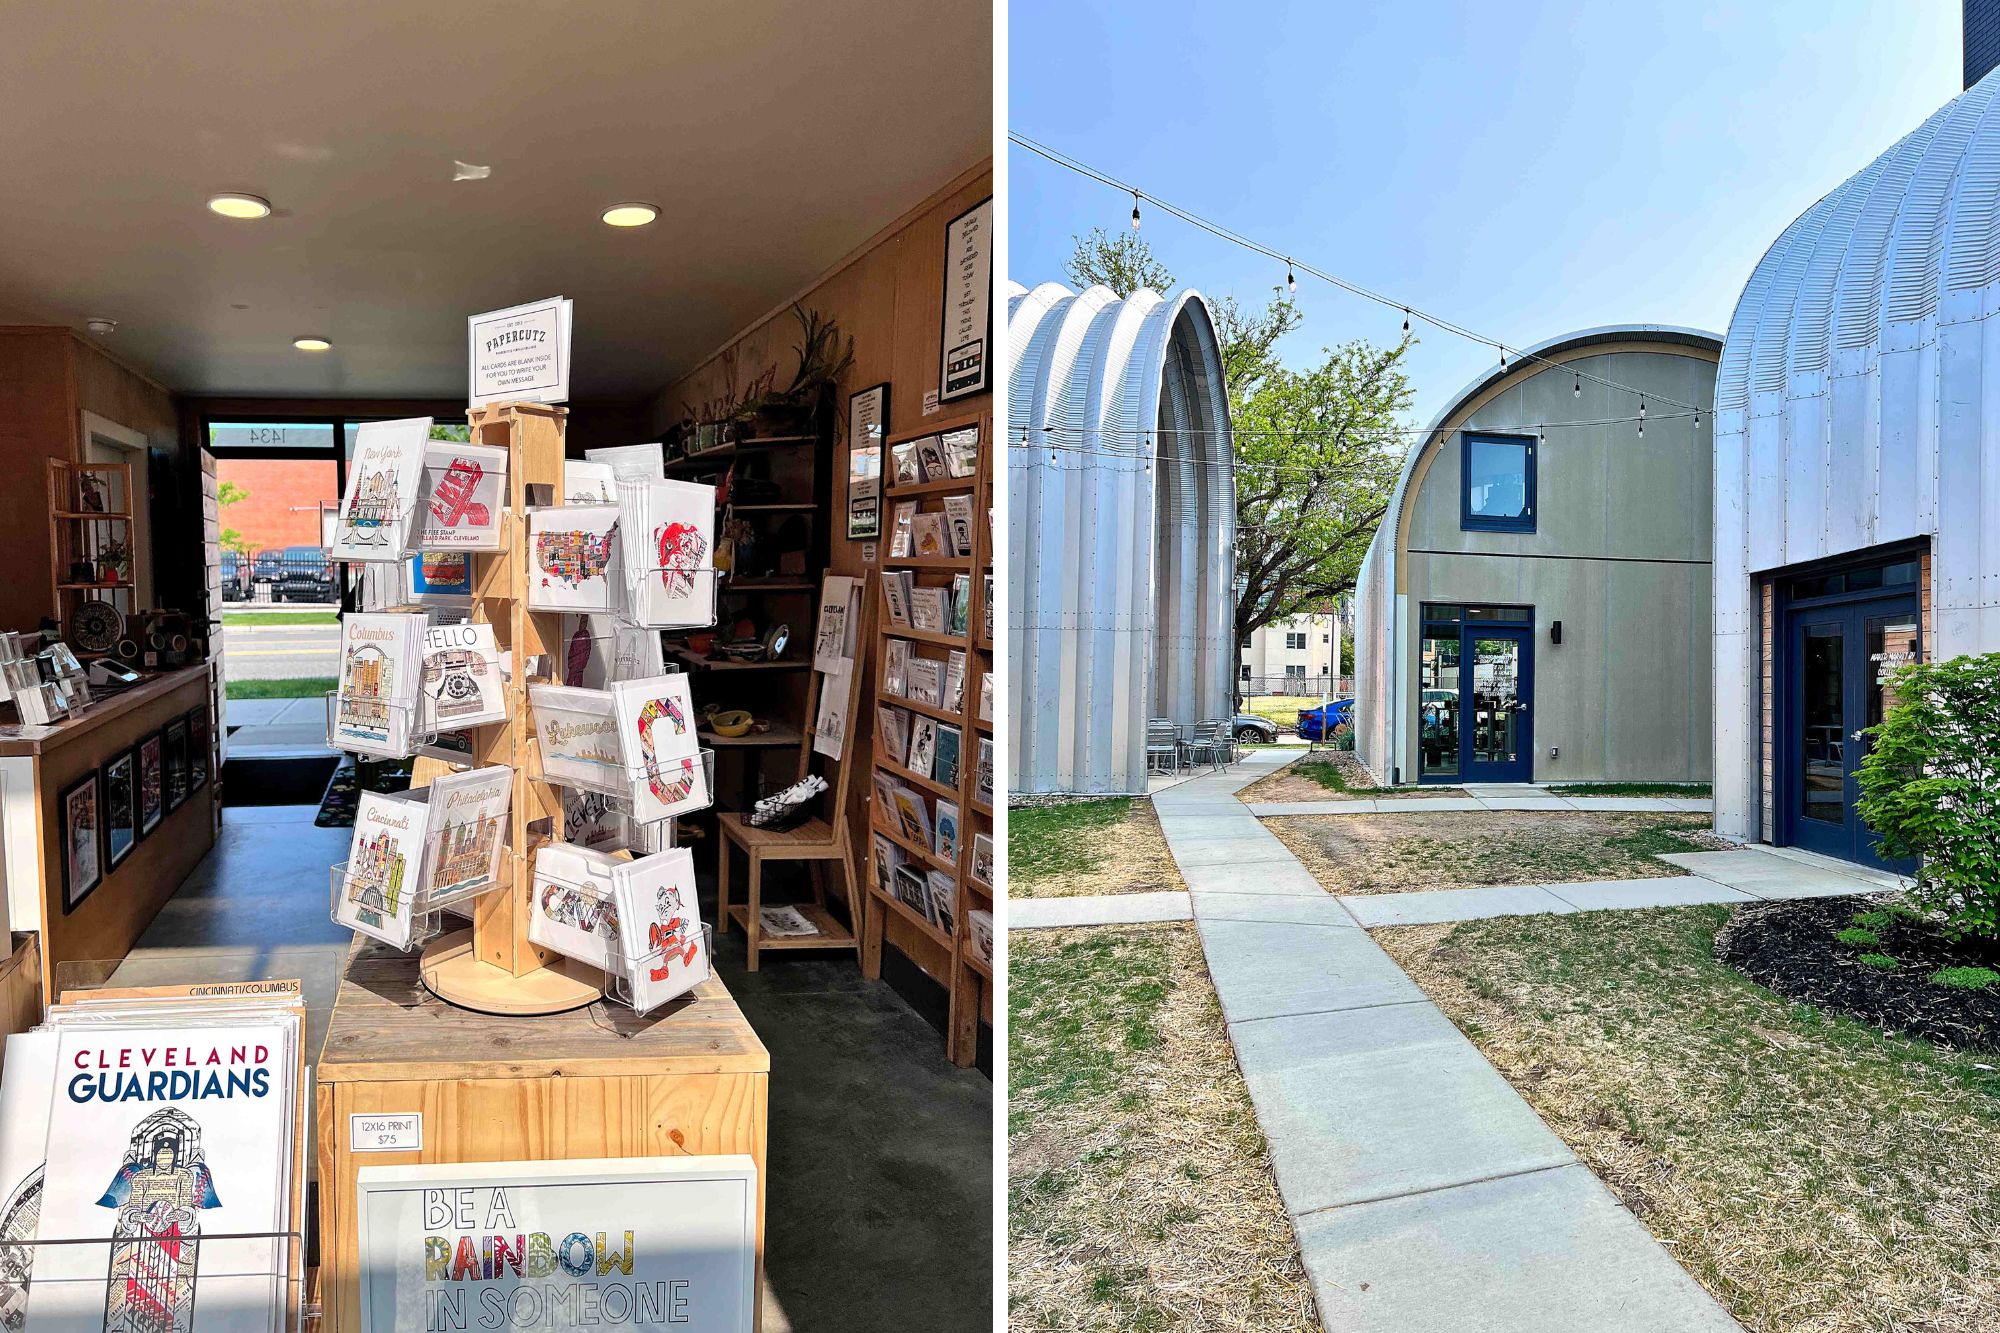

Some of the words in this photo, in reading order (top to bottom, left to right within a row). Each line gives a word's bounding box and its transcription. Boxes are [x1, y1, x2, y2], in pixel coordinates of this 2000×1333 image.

[486, 329, 546, 352] PAPERCUTZ
[490, 362, 507, 370] CARDS
[517, 357, 535, 366] BLANK
[535, 354, 552, 362] INSIDE
[496, 369, 508, 377] YOU
[516, 366, 532, 374] WRITE
[532, 364, 547, 372] YOUR
[497, 378, 511, 386] OWN
[511, 375, 535, 384] MESSAGE
[380, 446, 403, 463] York
[348, 623, 395, 641] Columbus
[446, 787, 502, 809] Philadelphia
[366, 806, 410, 831] Cincinnati
[189, 981, 299, 996] CINCINNATI/COLUMBUS
[74, 1045, 270, 1070] CLEVELAND
[67, 1067, 270, 1104] GUARDIANS
[361, 1121, 386, 1131] 12X16
[388, 1120, 412, 1131] PRINT
[378, 1134, 397, 1145] $75
[423, 1187, 475, 1231] BE
[485, 1186, 516, 1230] A
[425, 1230, 635, 1281] RAINBOW
[425, 1288, 467, 1332] IN
[477, 1280, 689, 1330] SOMEONE
